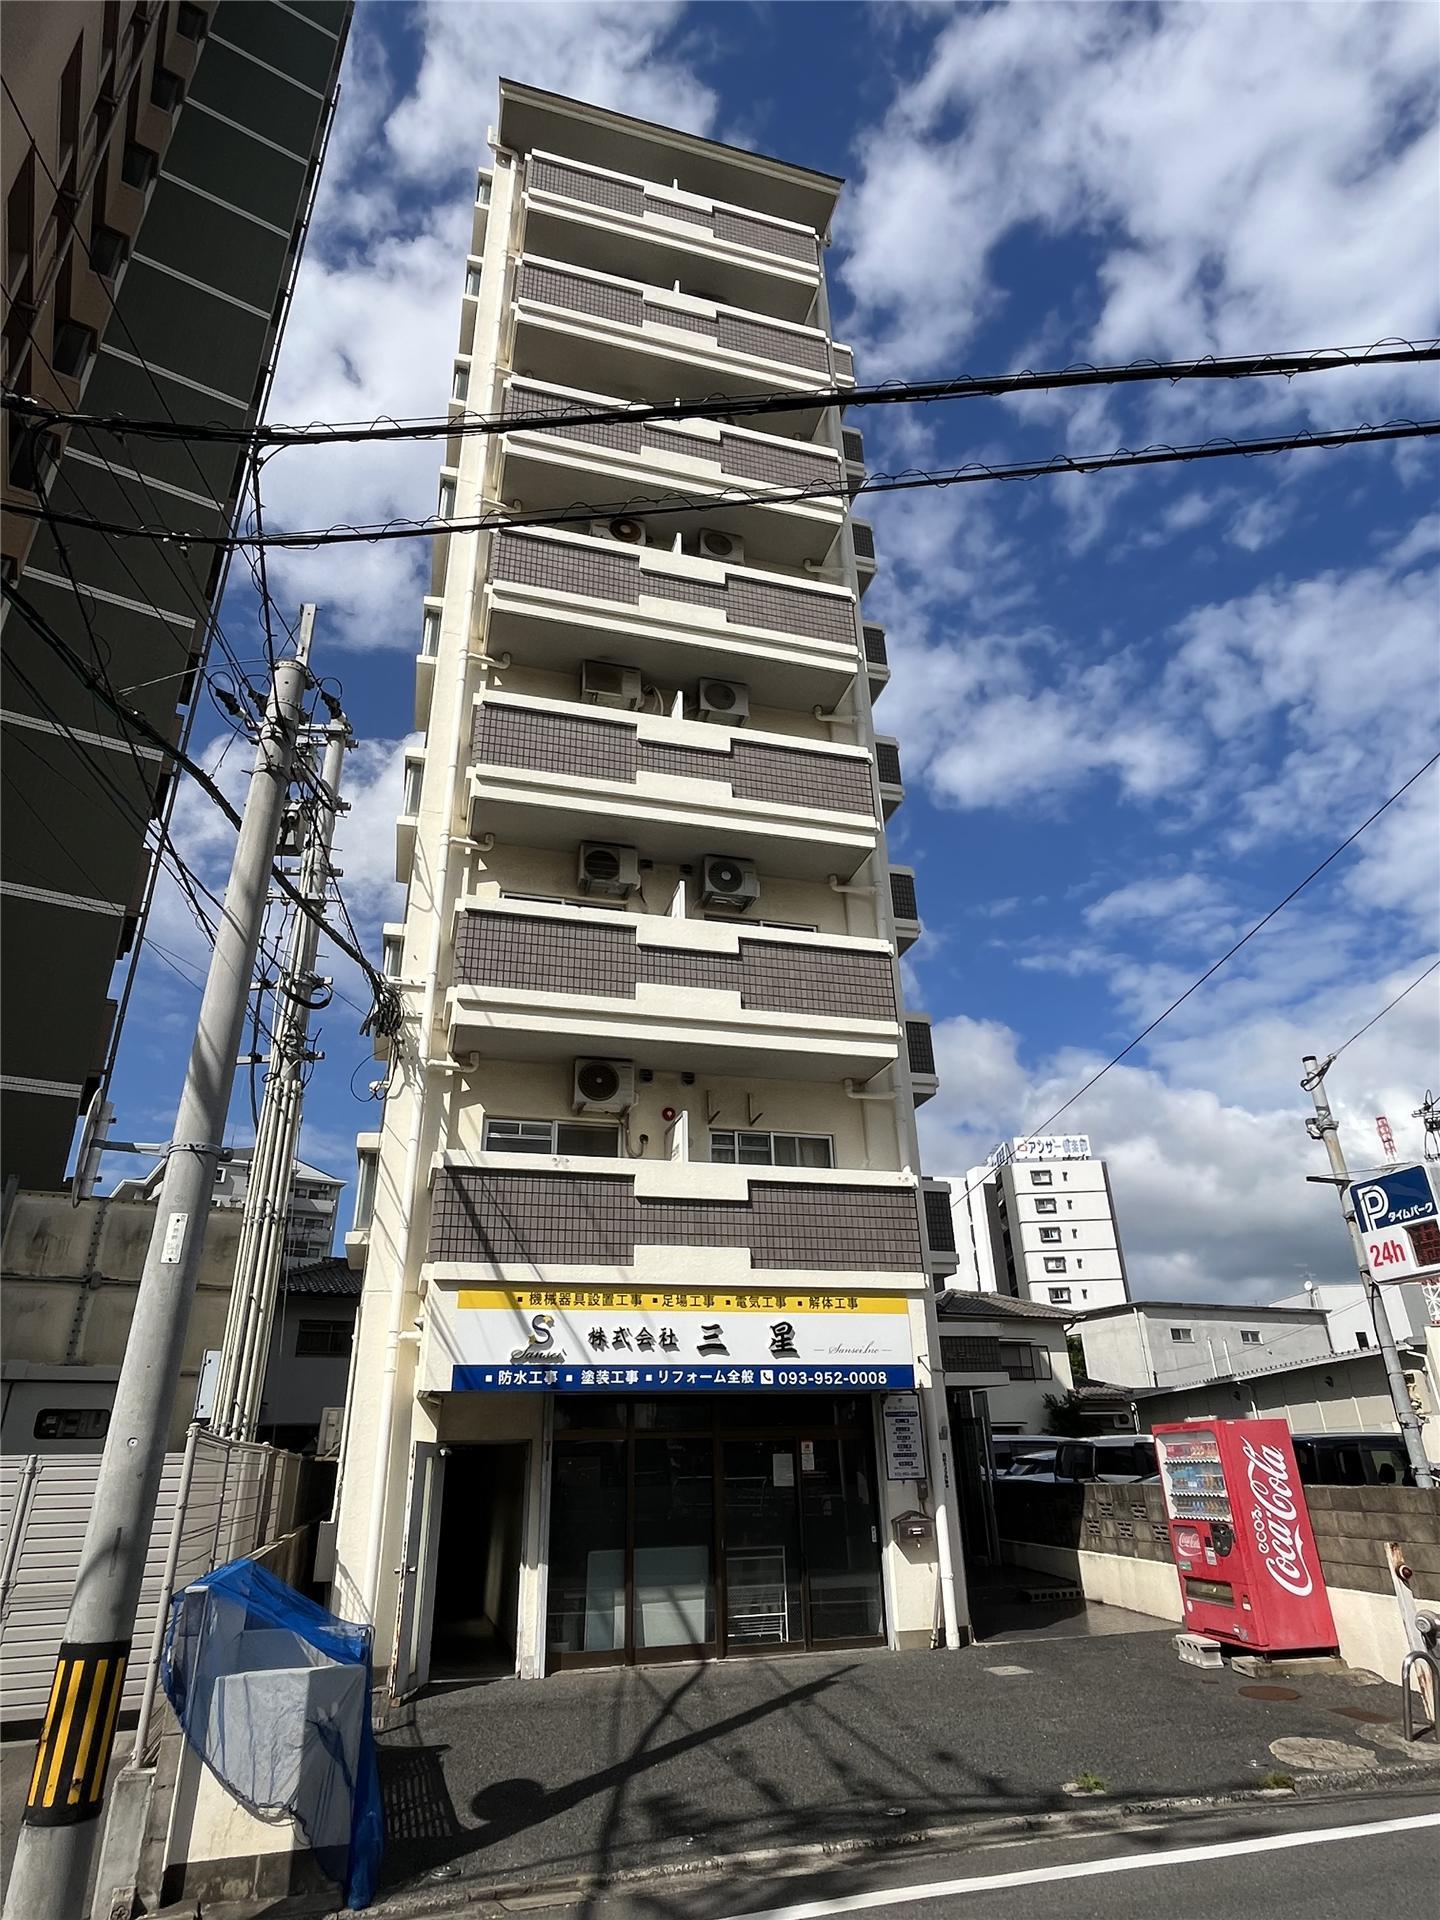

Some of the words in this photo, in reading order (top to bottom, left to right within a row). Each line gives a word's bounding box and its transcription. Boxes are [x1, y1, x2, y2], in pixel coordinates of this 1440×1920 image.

[1357, 1184, 1389, 1232] P
[1388, 1202, 1433, 1222] タイムパーク
[1369, 1240, 1406, 1268] 24h
[529, 1291, 642, 1307] 機械器具設置工事
[661, 1294, 715, 1308] 足場工事
[736, 1296, 787, 1309] 電気工事
[808, 1297, 859, 1310] 解体工事
[587, 1326, 678, 1350] 株式会社
[498, 1370, 558, 1385] 防水工事
[580, 1370, 639, 1385] 塗装工事
[658, 1370, 754, 1385] リフォーム全般
[778, 1371, 888, 1386] 093-952-0008
